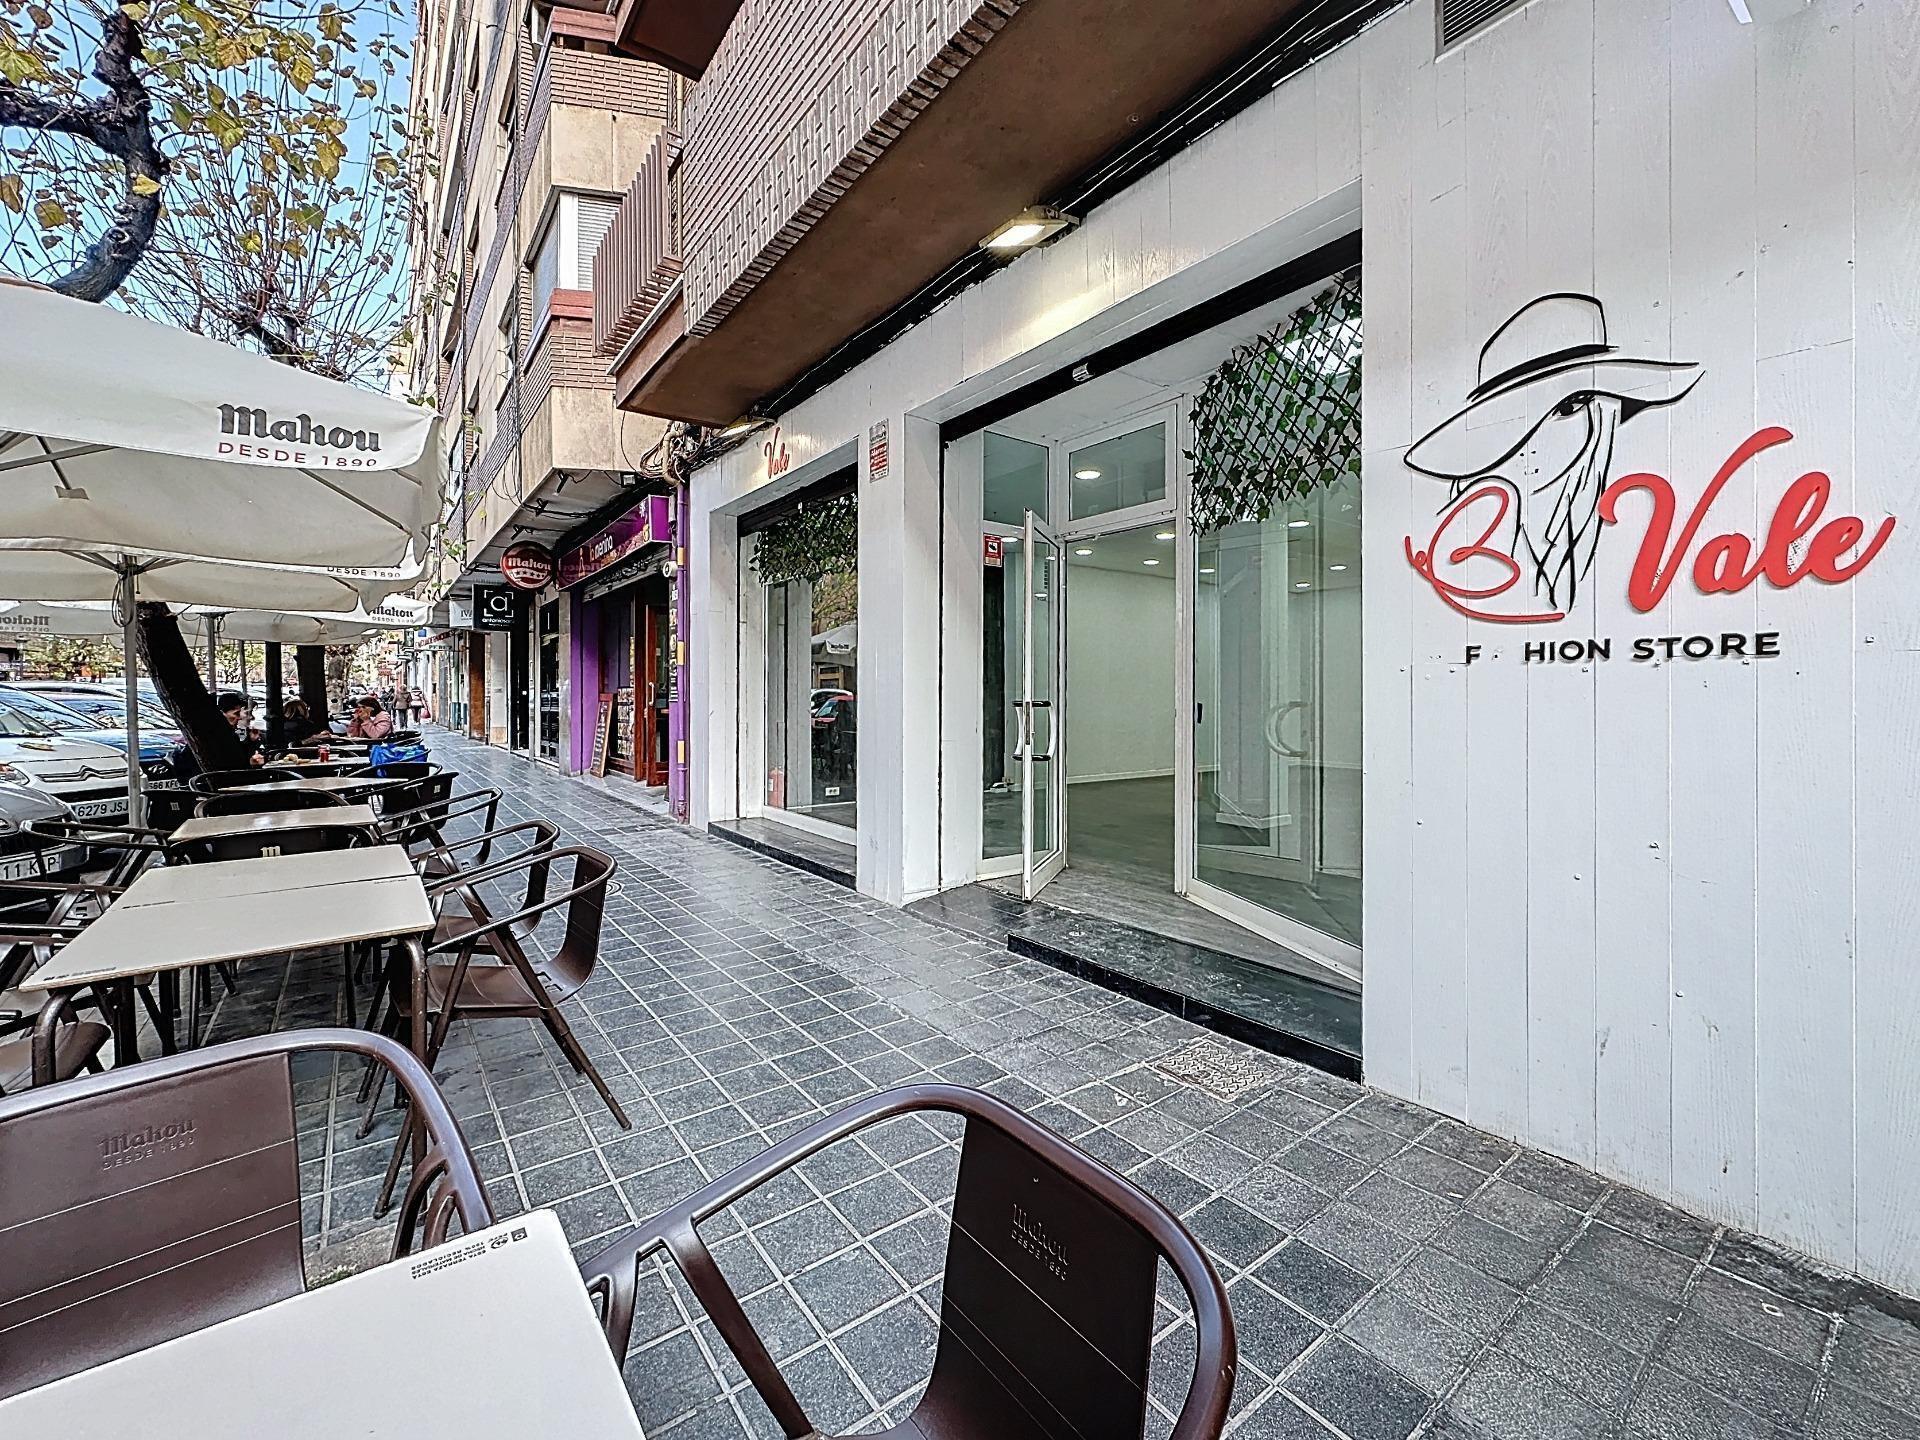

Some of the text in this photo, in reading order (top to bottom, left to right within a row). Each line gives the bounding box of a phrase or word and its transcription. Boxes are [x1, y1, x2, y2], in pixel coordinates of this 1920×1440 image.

[218, 442, 377, 467] DESDE 1890
[1598, 426, 1896, 612] Vale
[327, 567, 400, 578] DESDE 1890
[1633, 631, 1781, 662] STORE
[77, 800, 129, 817] 6279 JSJ
[29, 856, 57, 875] KP
